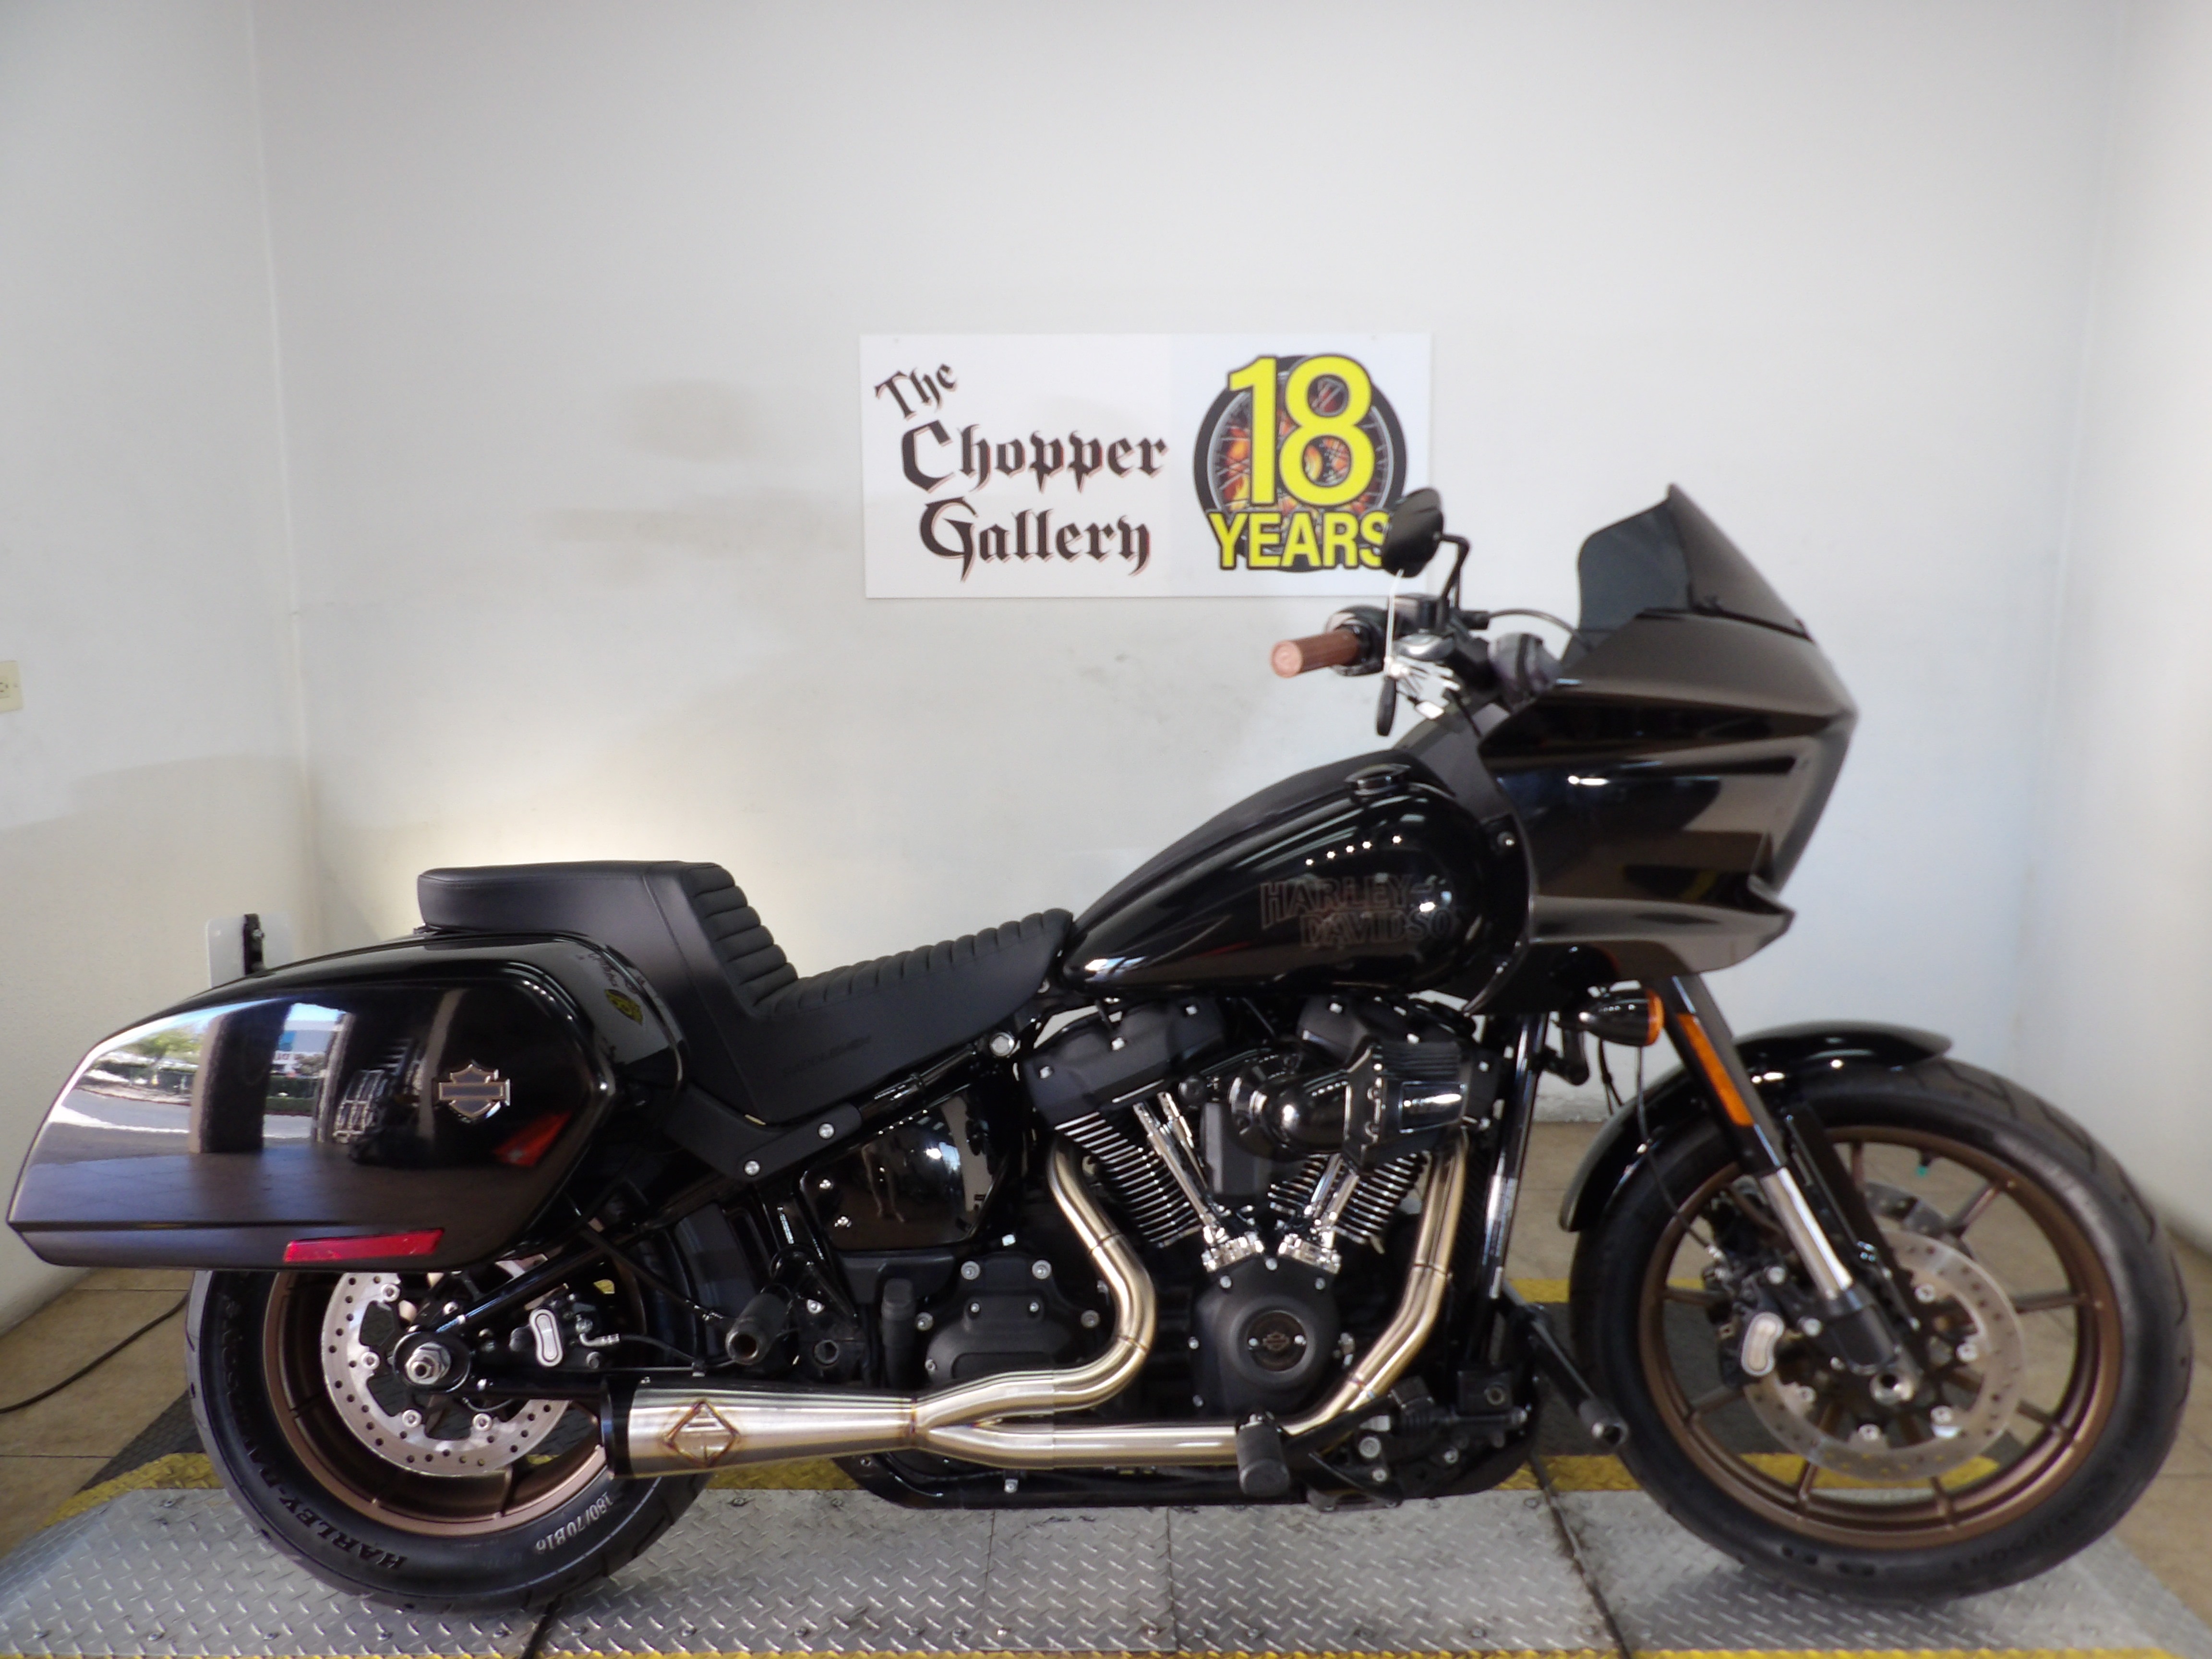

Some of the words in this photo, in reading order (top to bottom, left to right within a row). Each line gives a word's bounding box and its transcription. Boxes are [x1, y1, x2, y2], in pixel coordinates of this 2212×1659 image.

[874, 363, 957, 421] The
[901, 419, 1168, 494] Chopper
[1227, 353, 1376, 508] 18
[918, 495, 1151, 583] Gallery
[1207, 510, 1390, 570] YEARS
